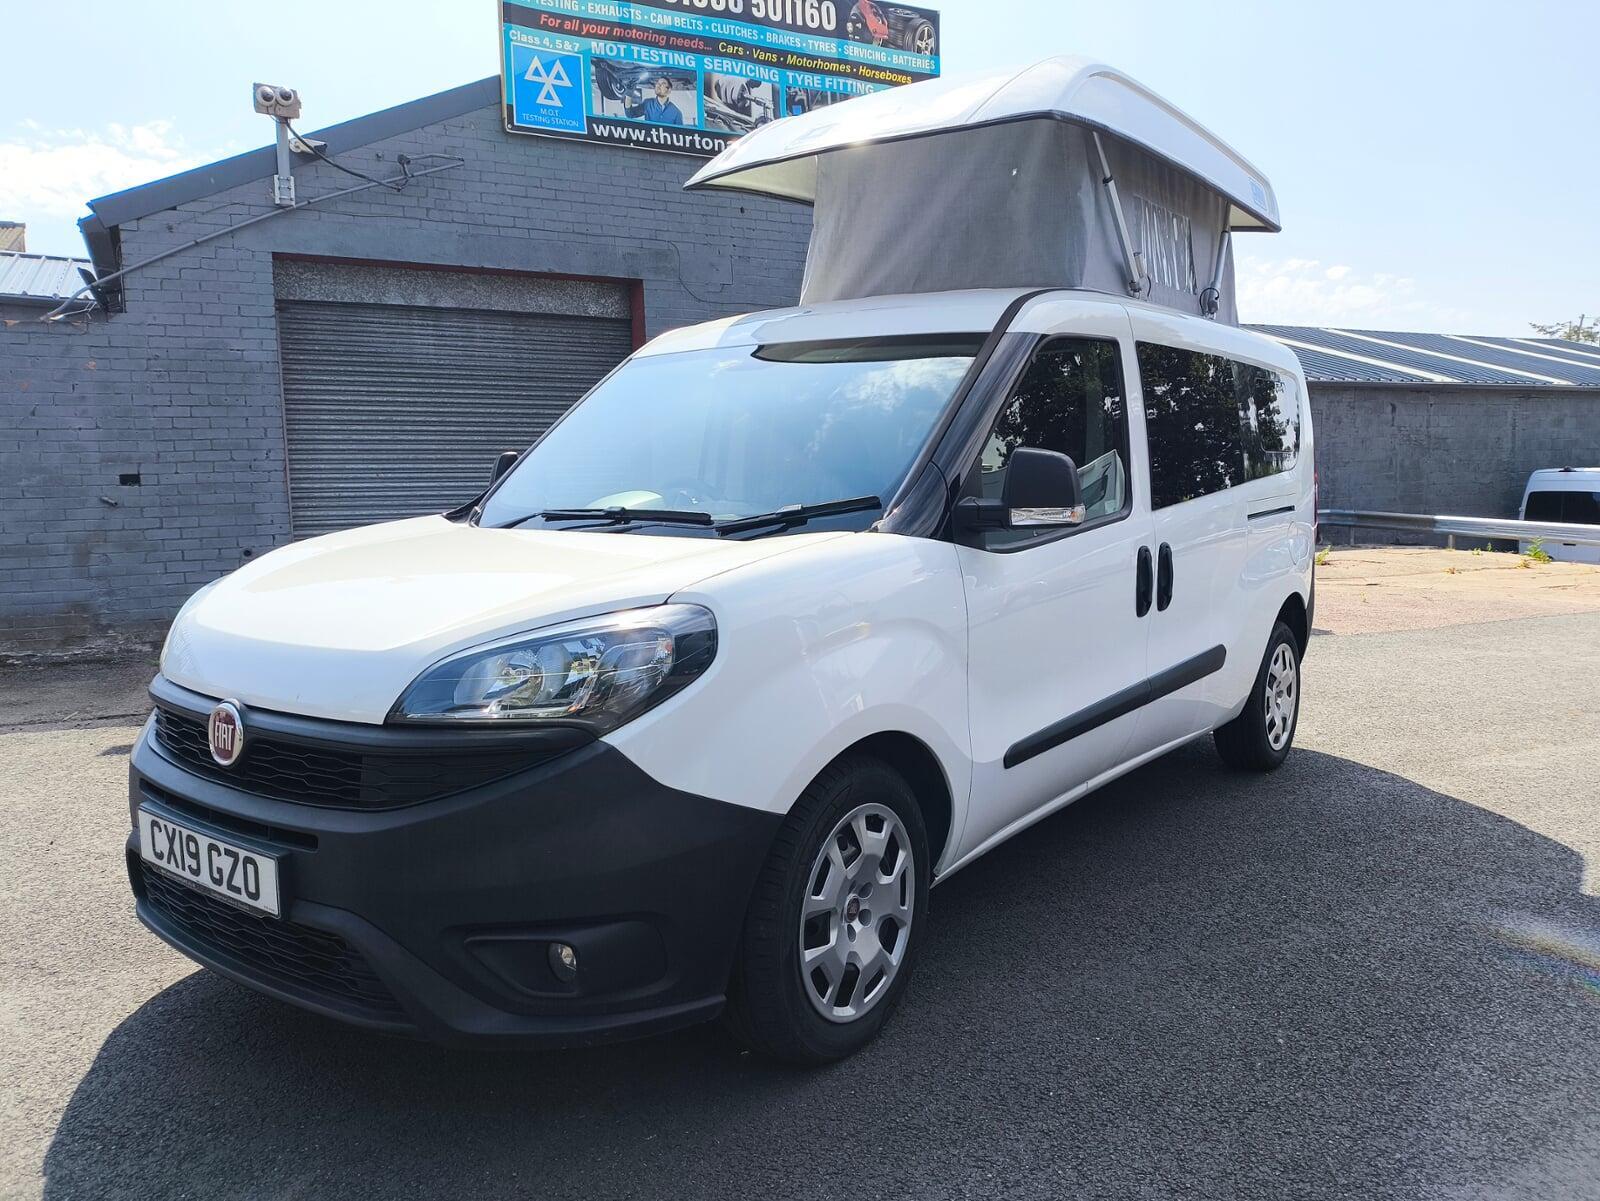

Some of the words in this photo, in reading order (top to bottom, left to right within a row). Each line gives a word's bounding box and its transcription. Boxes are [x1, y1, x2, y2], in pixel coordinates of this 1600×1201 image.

[752, 0, 836, 31] 501160
[509, 29, 540, 45] Class
[540, 14, 561, 28] For
[563, 19, 580, 31] all
[581, 23, 611, 36] your
[613, 26, 667, 46] motoring
[718, 41, 744, 56] Cars
[752, 48, 778, 62] Vans
[786, 54, 851, 73] Motorhomes
[858, 65, 912, 84] Horseboxes
[587, 2, 642, 20] EXHAUSTS
[650, 12, 672, 26] CAM
[674, 17, 703, 31] BELTS
[711, 22, 759, 40] CLUTCHES
[766, 32, 800, 47] BRAKES
[807, 39, 837, 53] TYRES
[843, 44, 886, 63] SERVICING
[892, 54, 936, 70] BATTERIES
[590, 41, 627, 58] MOT
[630, 44, 696, 68] TESTING
[703, 57, 779, 82] SERVICING
[786, 71, 821, 87] TYRE
[825, 77, 874, 94] FITTING
[522, 113, 550, 124] TESTING
[551, 118, 579, 127] STATION
[592, 123, 734, 152] www.thurton
[214, 721, 234, 751] FIAT
[150, 819, 201, 878] CX19
[207, 842, 260, 902] GZO
